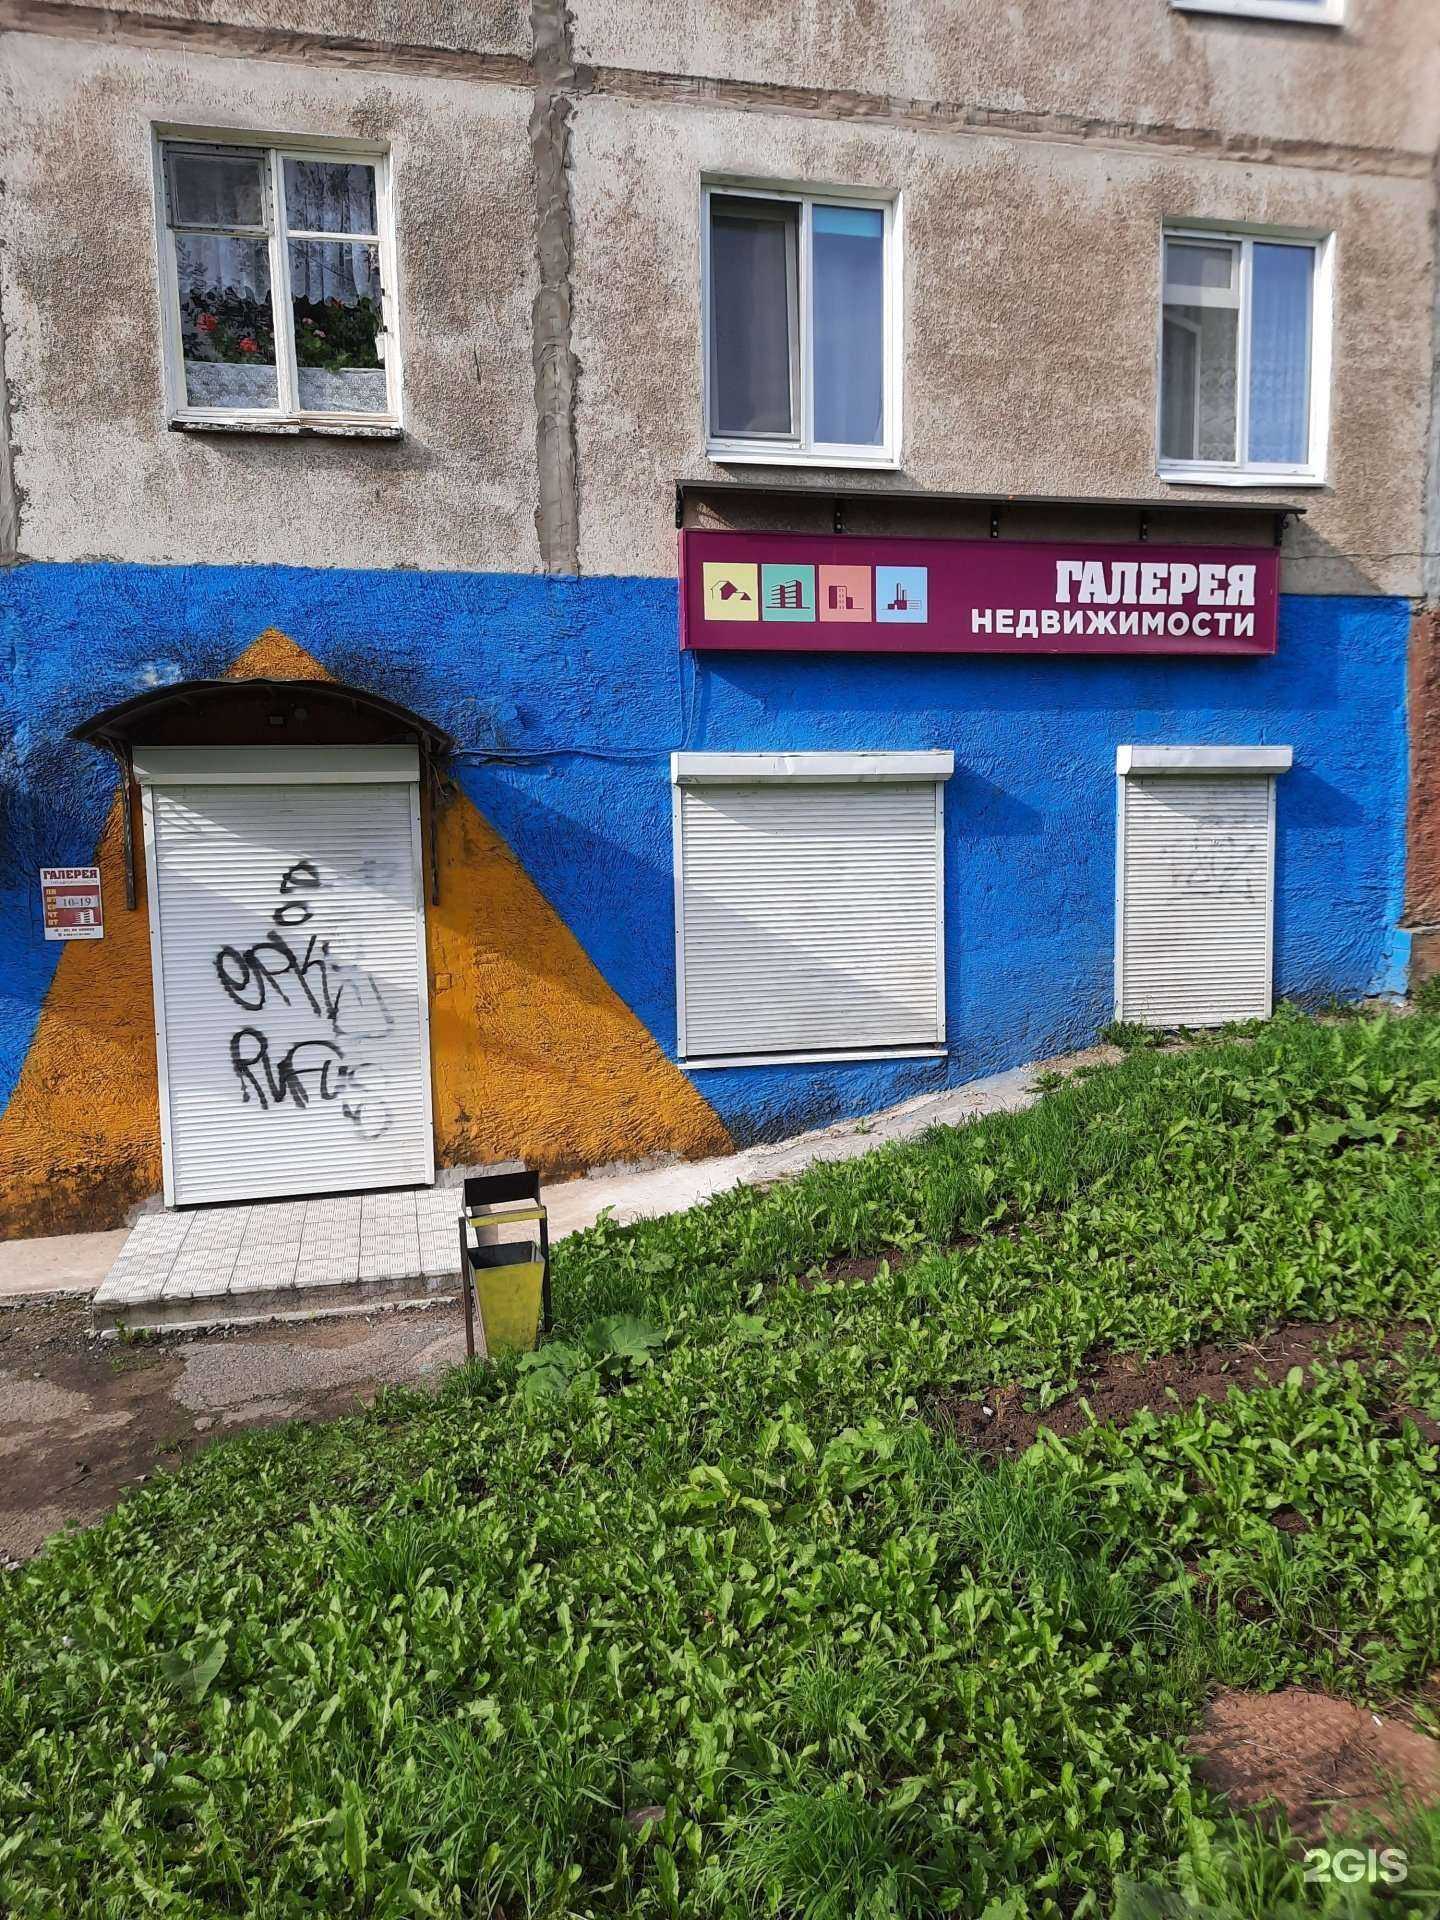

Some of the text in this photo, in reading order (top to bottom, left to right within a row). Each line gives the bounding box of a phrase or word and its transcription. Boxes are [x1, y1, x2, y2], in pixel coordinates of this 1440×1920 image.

[1055, 560, 1256, 606] ГАЛЕРЕЯ
[971, 608, 1255, 639] НЕДВИЖИМОСТИ
[43, 869, 98, 880] ГАЛЕРЕЯ
[63, 897, 92, 907] 10-19
